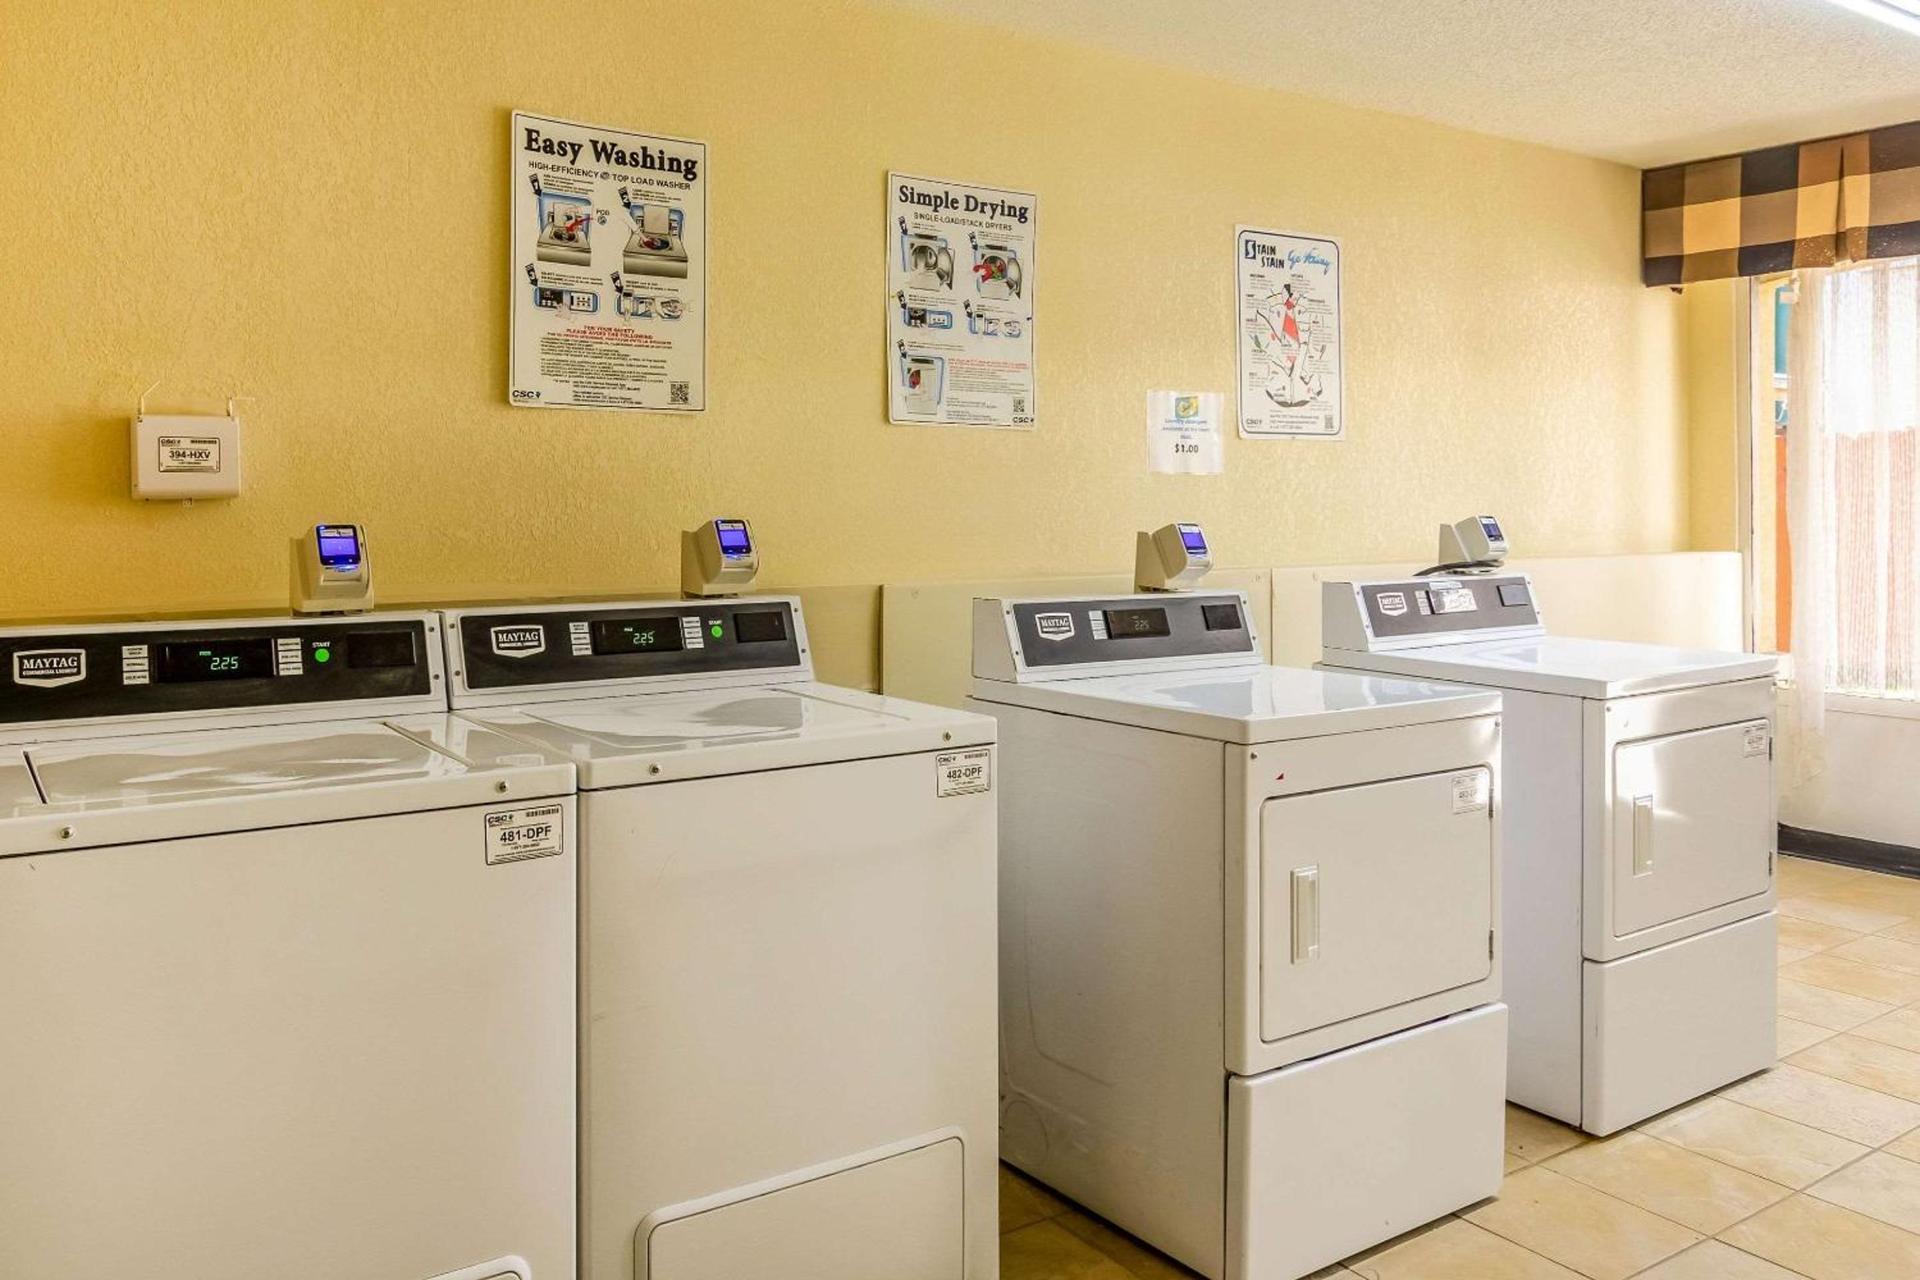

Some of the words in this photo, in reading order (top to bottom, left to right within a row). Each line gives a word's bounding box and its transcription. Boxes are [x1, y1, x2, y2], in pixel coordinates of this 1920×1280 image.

[524, 128, 584, 165] Easy
[589, 139, 698, 182] Washing
[528, 161, 599, 179] HIGH-EFFICIENCY
[612, 173, 629, 184] TOP
[631, 176, 654, 187] LOAD
[656, 180, 691, 191] WASHER
[899, 185, 960, 213] Simple
[964, 194, 1029, 224] Drying
[985, 222, 1013, 232] DRYERS
[1261, 256, 1285, 269] STAIN
[512, 390, 535, 398] CSC
[169, 450, 211, 459] 394-HXV
[1175, 443, 1199, 454] $1.00
[498, 631, 539, 642] MAYTAG
[23, 656, 78, 669] MAYTAG
[211, 656, 239, 670] 2.25
[947, 766, 983, 779] 482-DPF
[500, 825, 552, 843] 481-DPF
